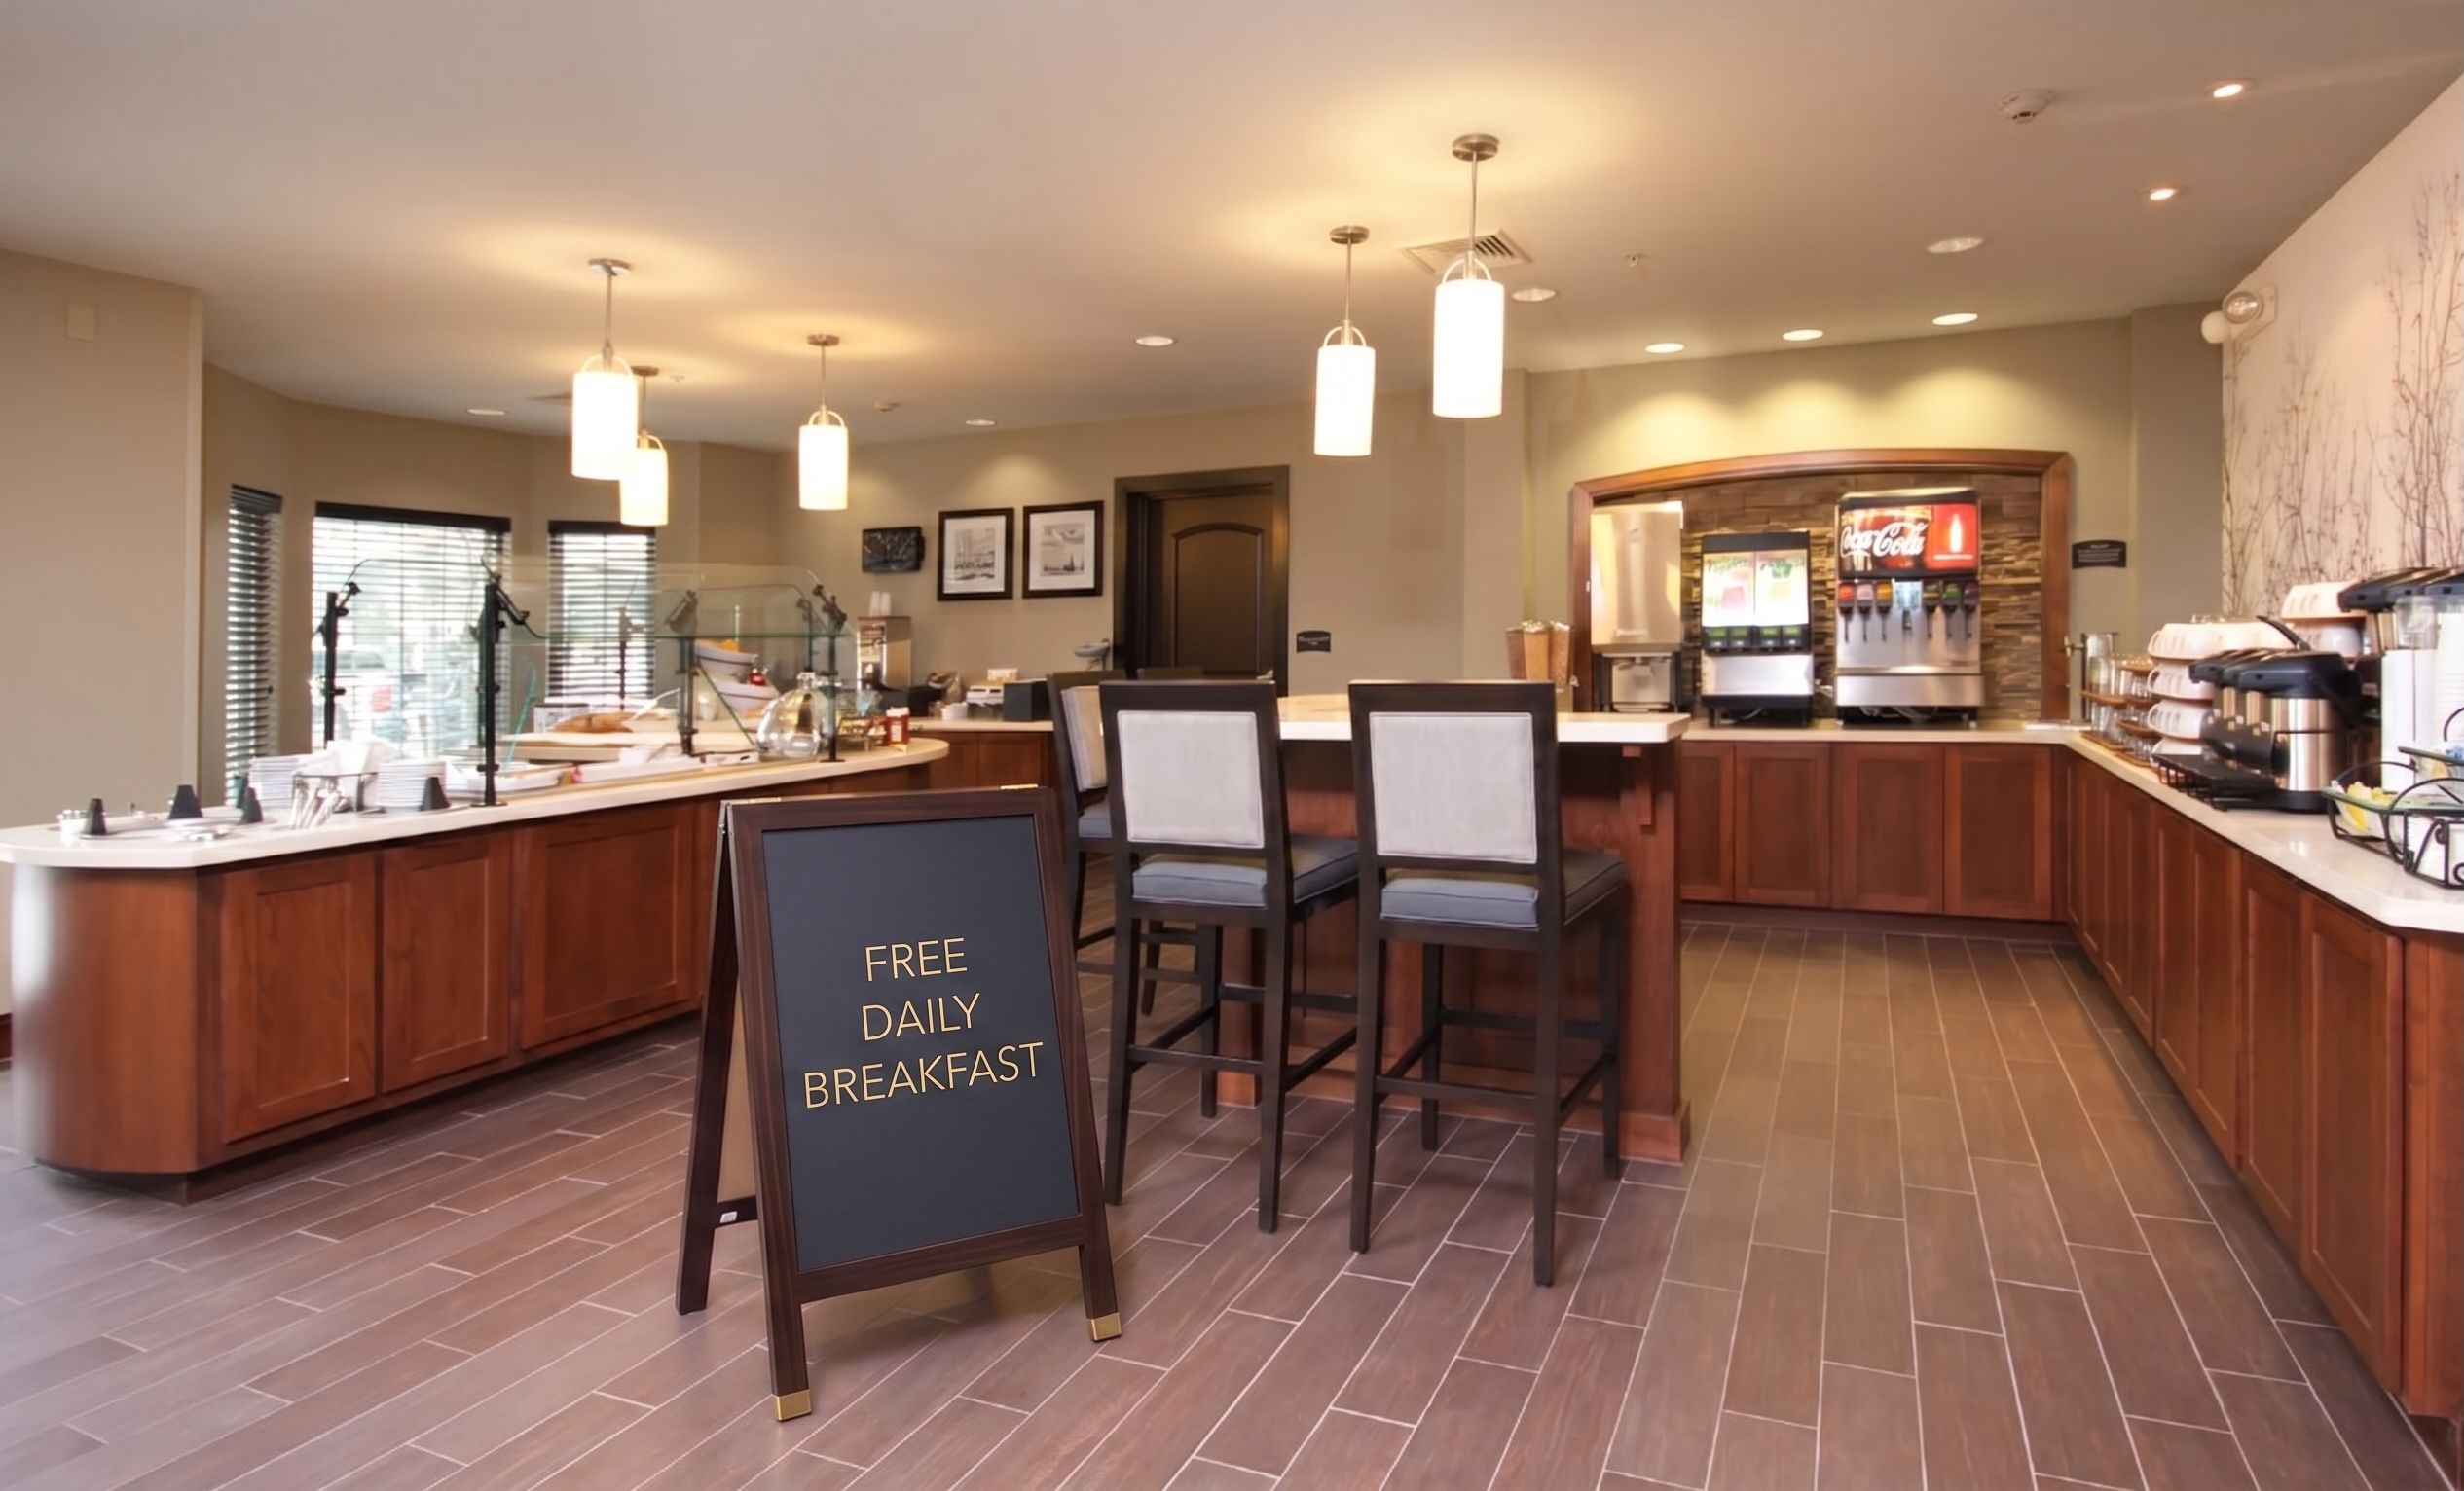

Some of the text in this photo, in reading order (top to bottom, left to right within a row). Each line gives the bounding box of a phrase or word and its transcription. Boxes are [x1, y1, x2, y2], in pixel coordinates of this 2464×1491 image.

[865, 938, 968, 981] FREE
[862, 993, 980, 1041] DAILY
[804, 1042, 1044, 1109] BREAKFAST
